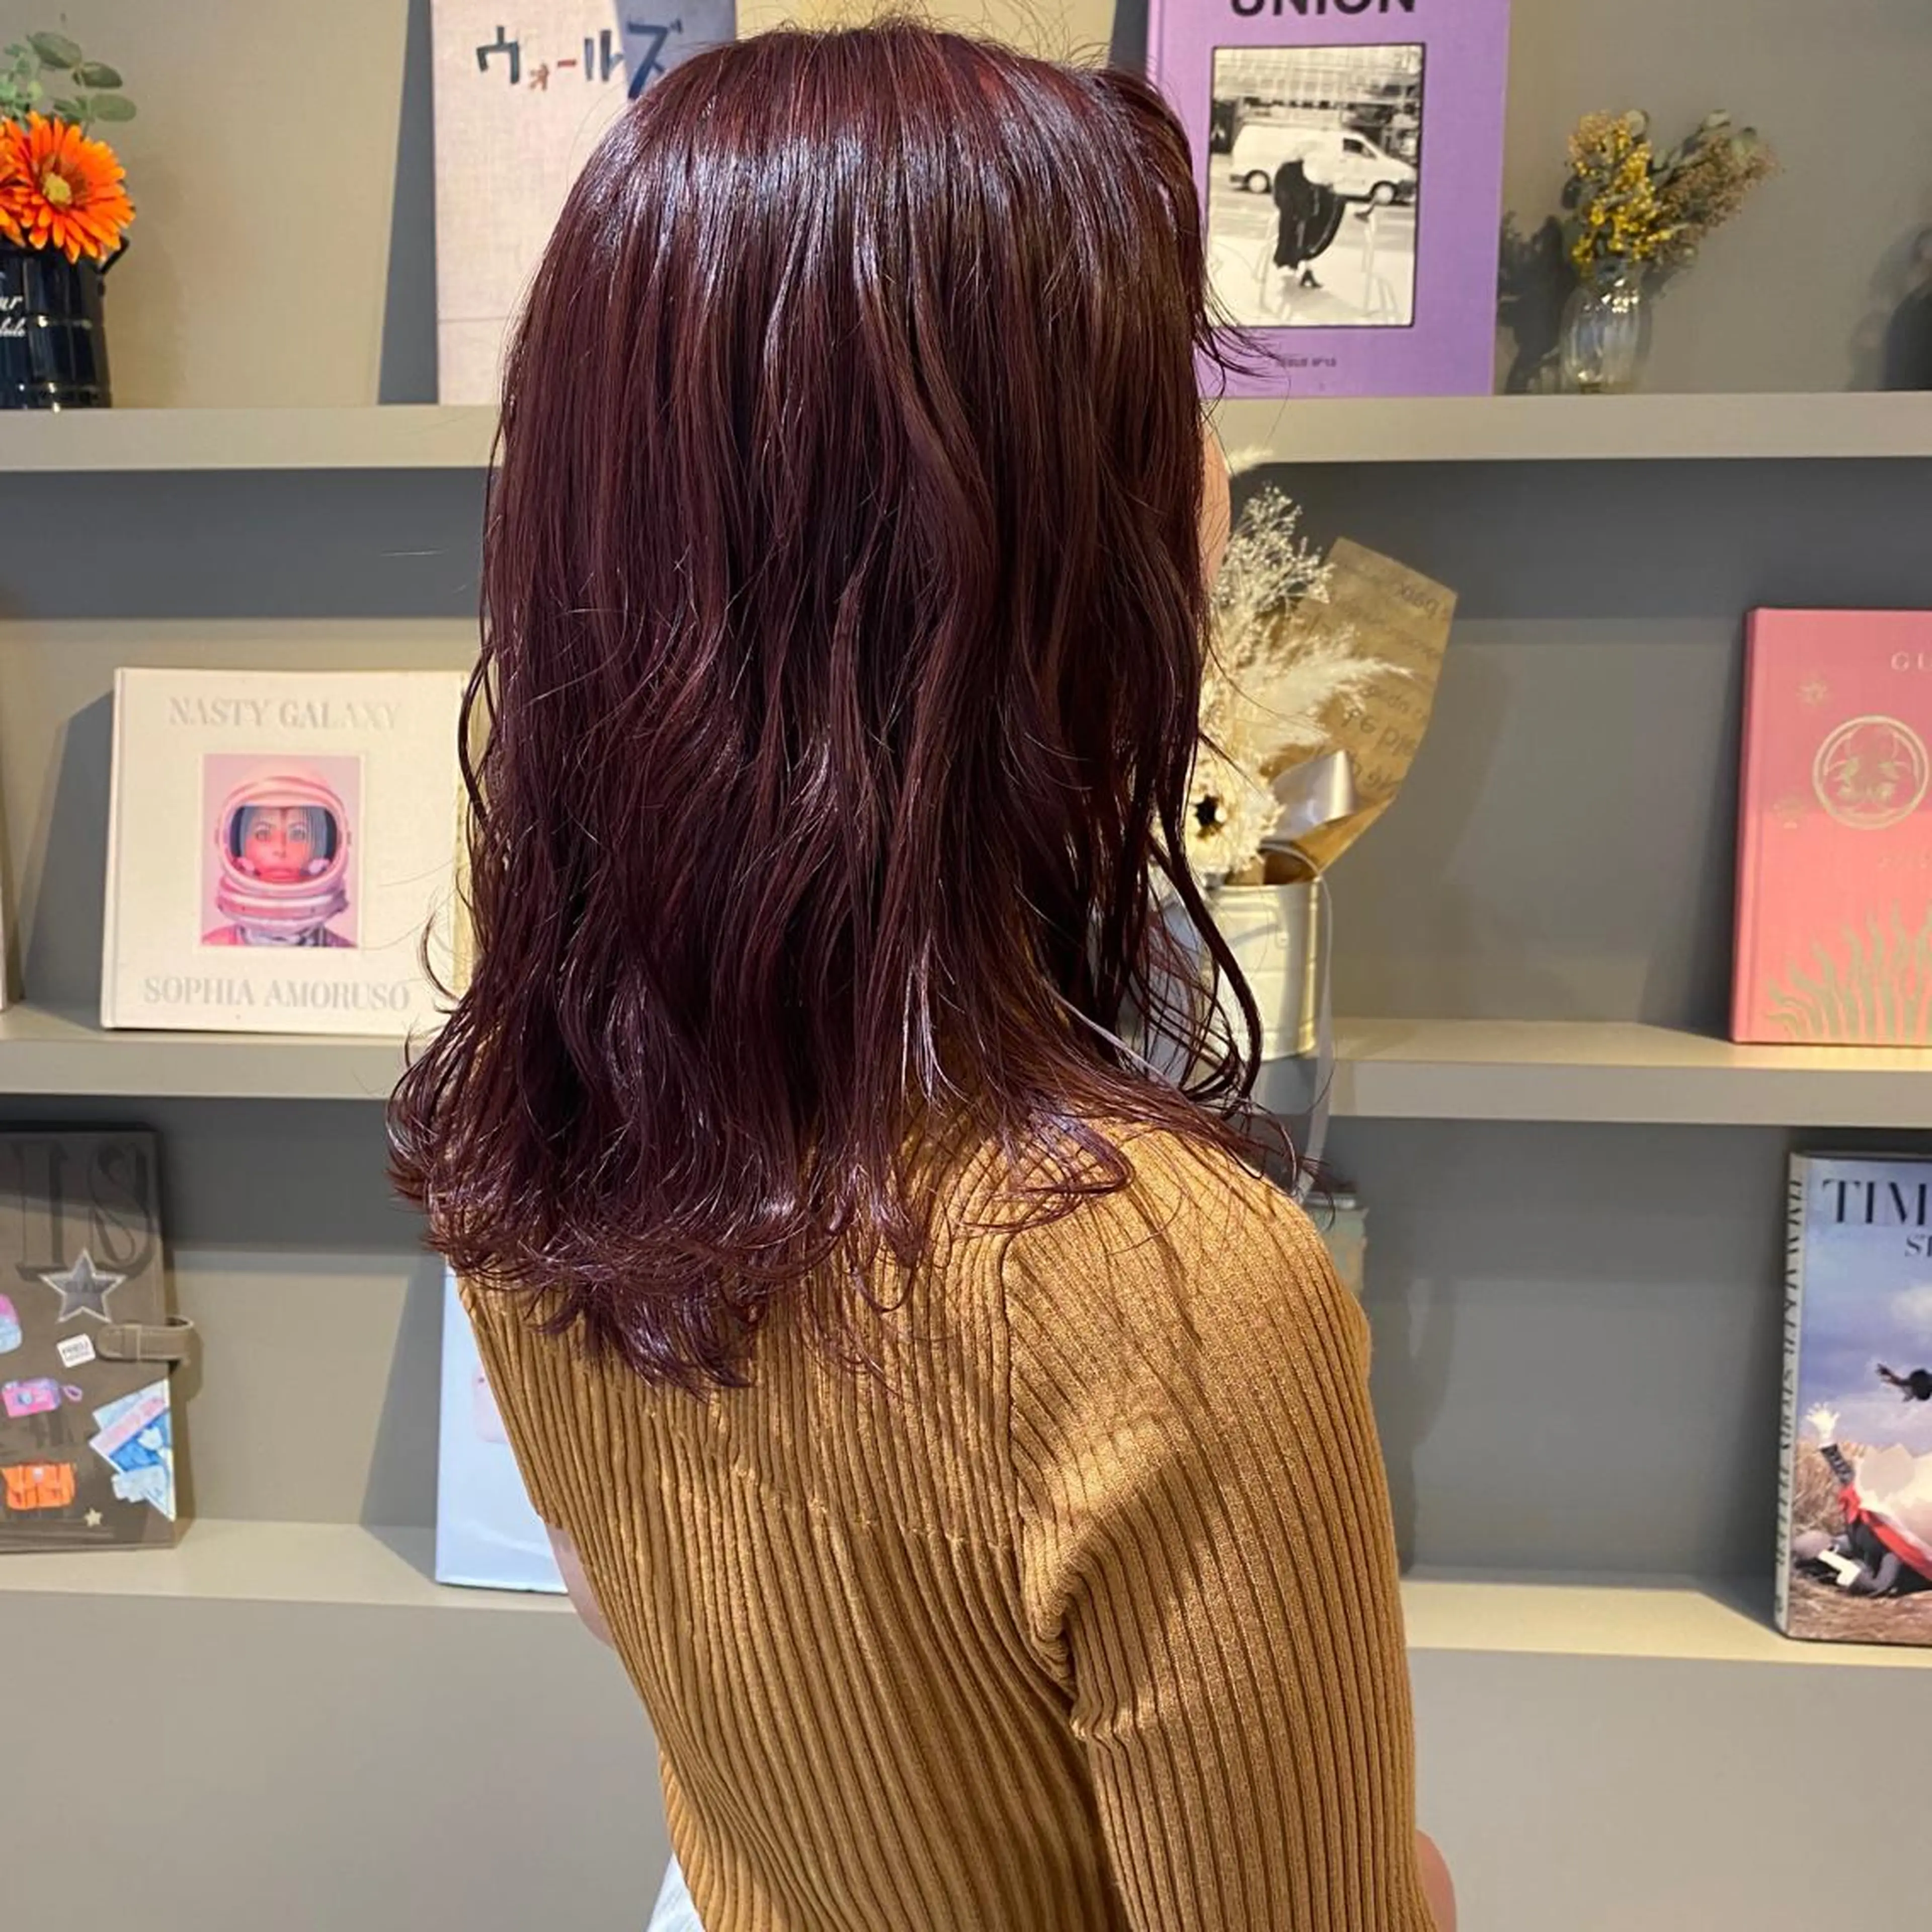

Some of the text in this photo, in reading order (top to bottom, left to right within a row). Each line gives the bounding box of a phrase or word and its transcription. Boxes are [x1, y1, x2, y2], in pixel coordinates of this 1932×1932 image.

[167, 696, 401, 730] NASTY GALAXY
[143, 975, 411, 1011] SOPHIA AMORUSO
[1822, 1178, 1927, 1226] TIM
